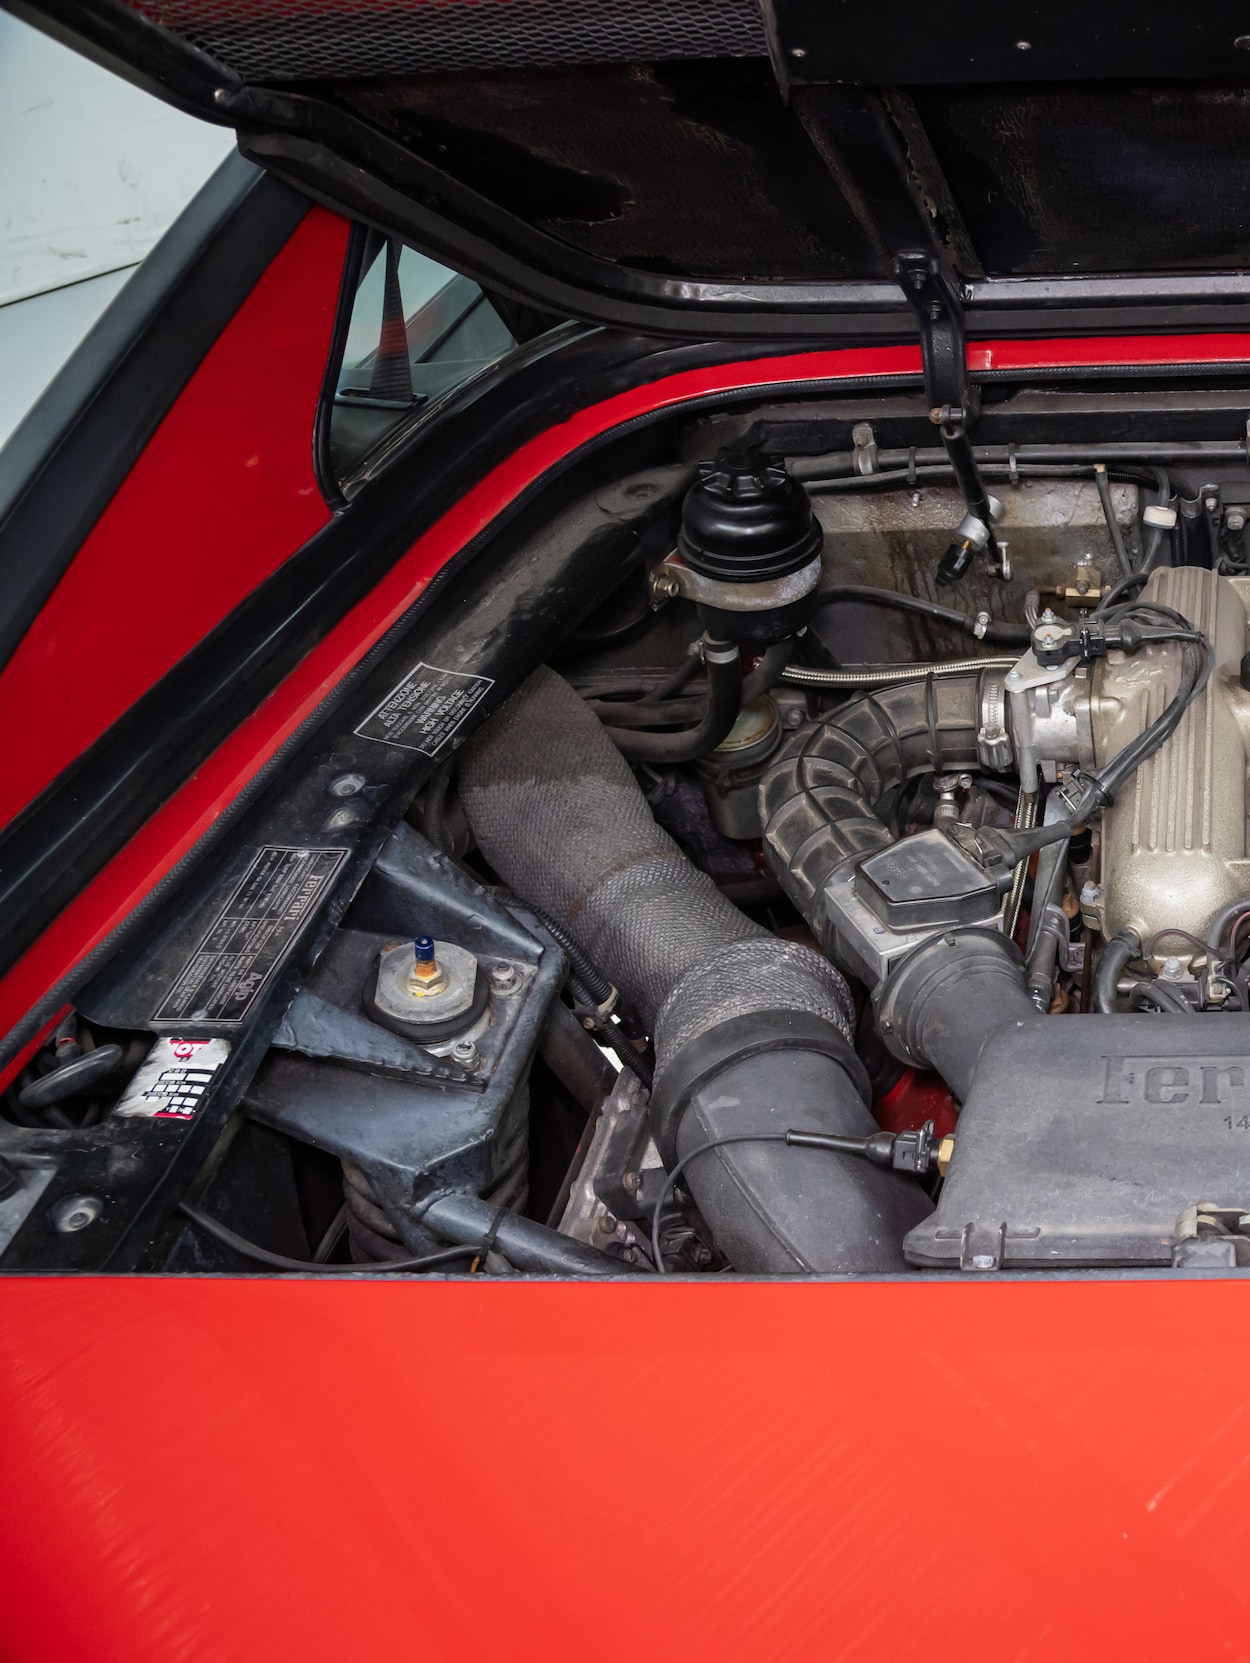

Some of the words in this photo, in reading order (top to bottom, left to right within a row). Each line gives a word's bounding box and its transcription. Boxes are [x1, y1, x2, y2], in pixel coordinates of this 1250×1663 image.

[375, 681, 418, 719] ATTENZIONE
[381, 711, 402, 727] ALTA
[397, 680, 431, 711] TENSIONE
[414, 694, 447, 724] WARNING
[418, 717, 439, 734] HIGH
[434, 688, 464, 716] VOLTAGE
[282, 875, 324, 920] Ferrari
[230, 971, 265, 1000] Agip
